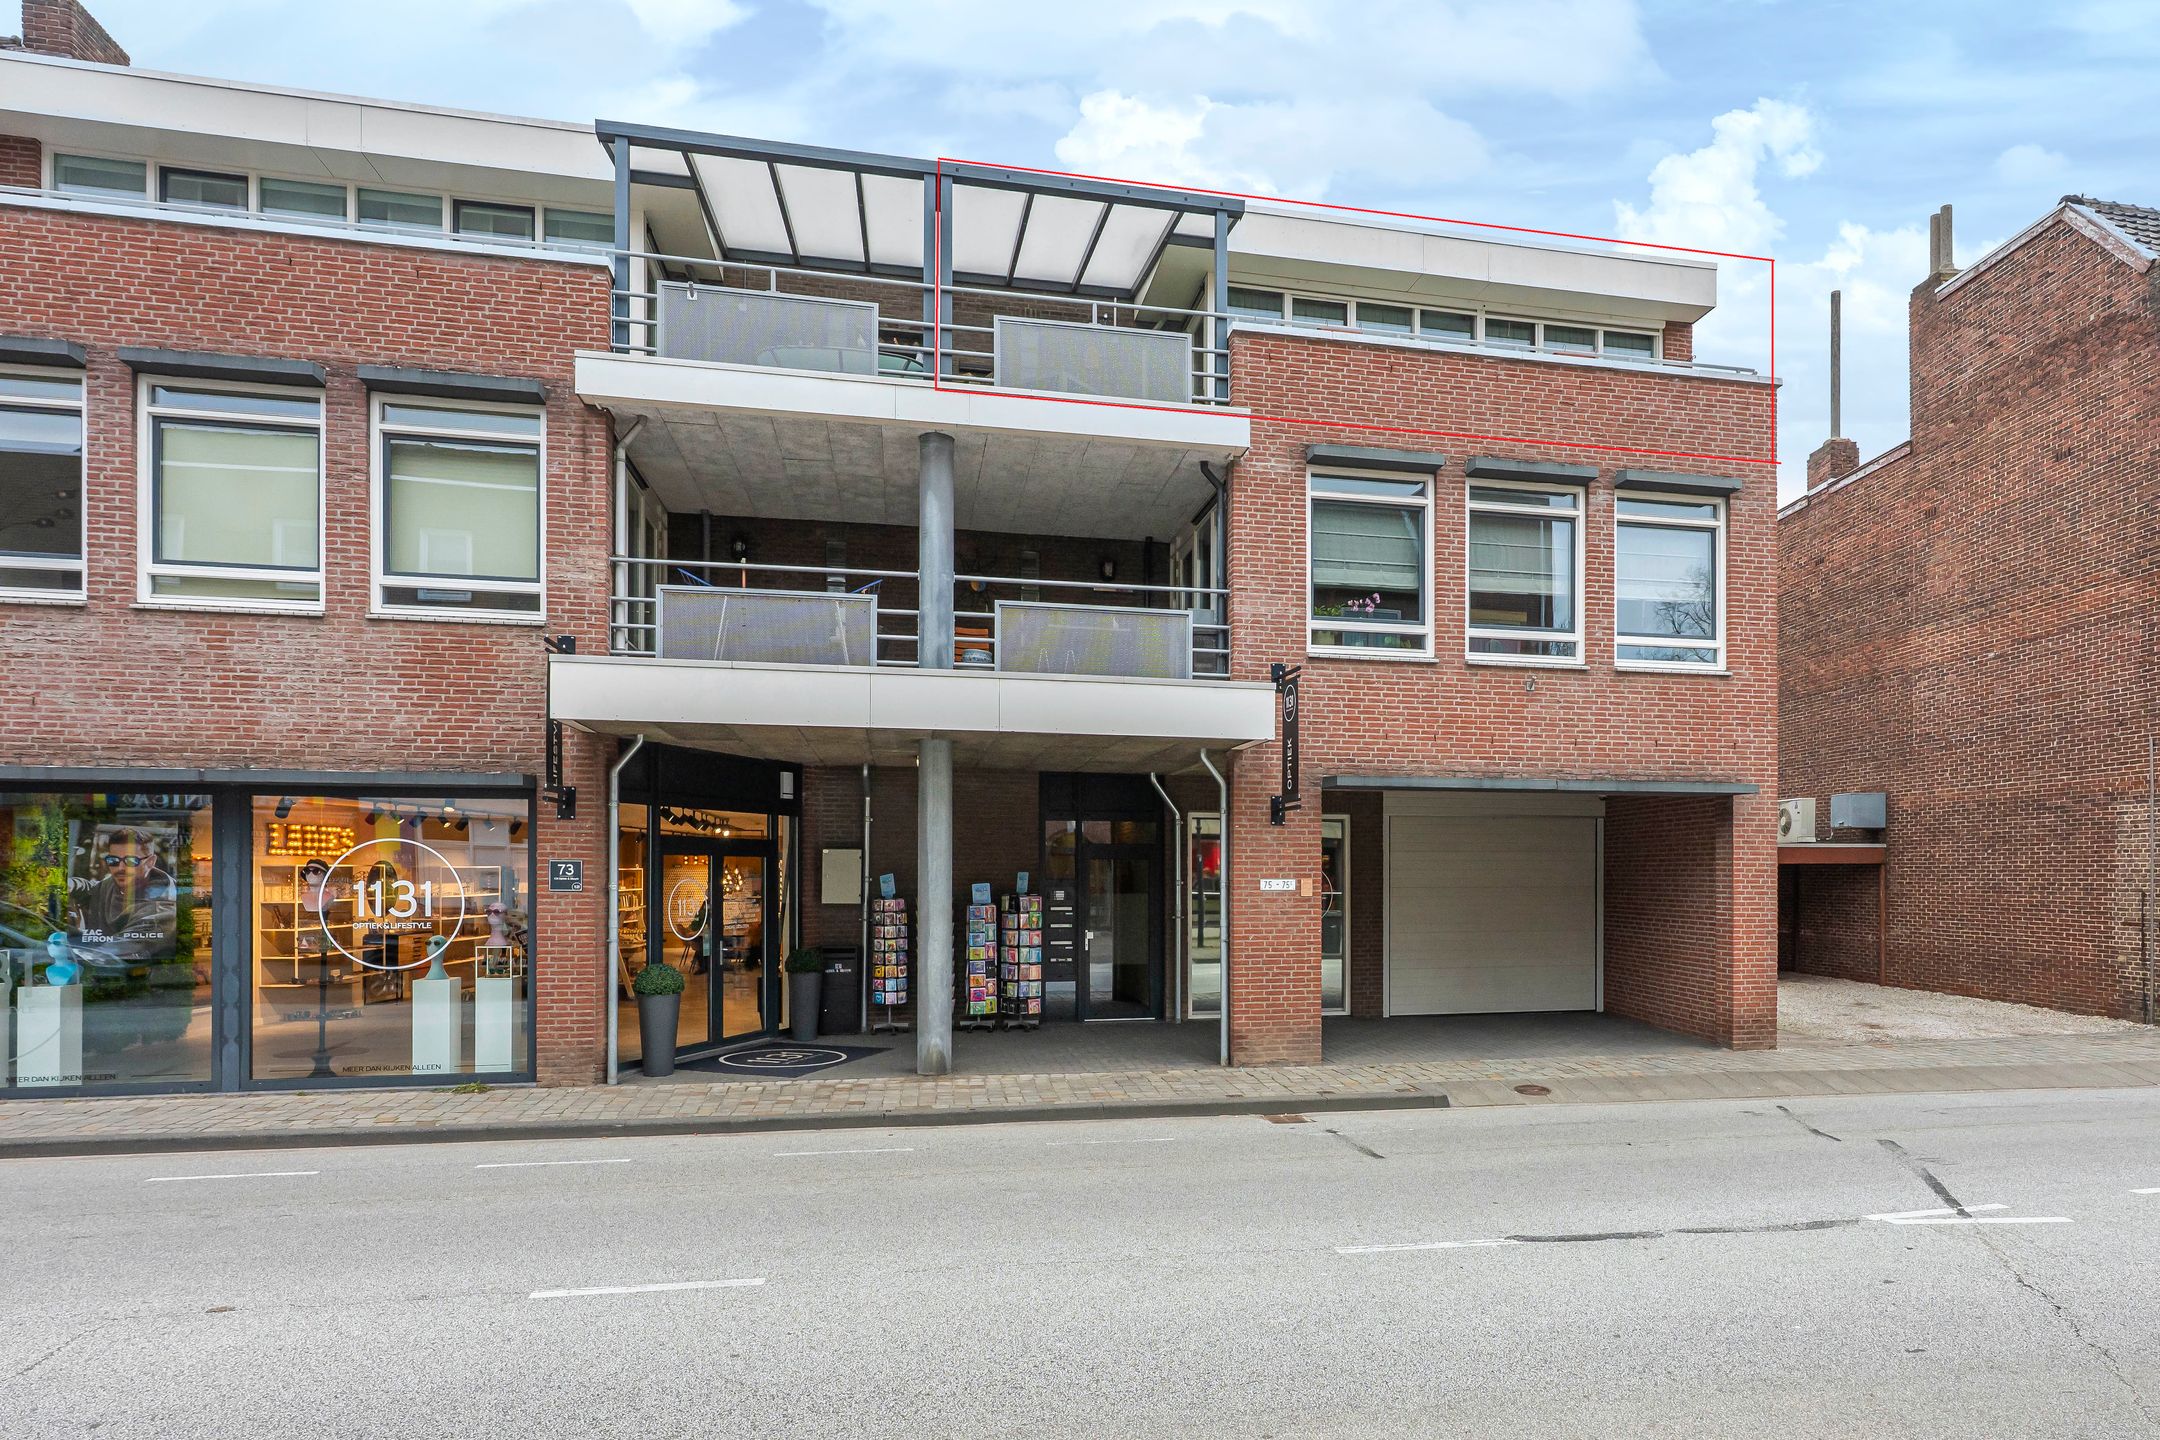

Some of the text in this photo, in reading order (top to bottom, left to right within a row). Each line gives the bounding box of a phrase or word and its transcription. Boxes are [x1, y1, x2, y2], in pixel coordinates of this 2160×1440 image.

[557, 863, 575, 876] 73
[1263, 880, 1273, 889] 75
[352, 879, 433, 919] 1131
[352, 922, 383, 930] OPTIEK
[82, 928, 103, 936] ZAC
[81, 935, 114, 943] EFRON
[342, 1065, 364, 1073] MEER
[382, 1064, 411, 1072] KIJKEN
[412, 1063, 442, 1071] ALLEEN
[51, 1074, 81, 1082] KIJKEN
